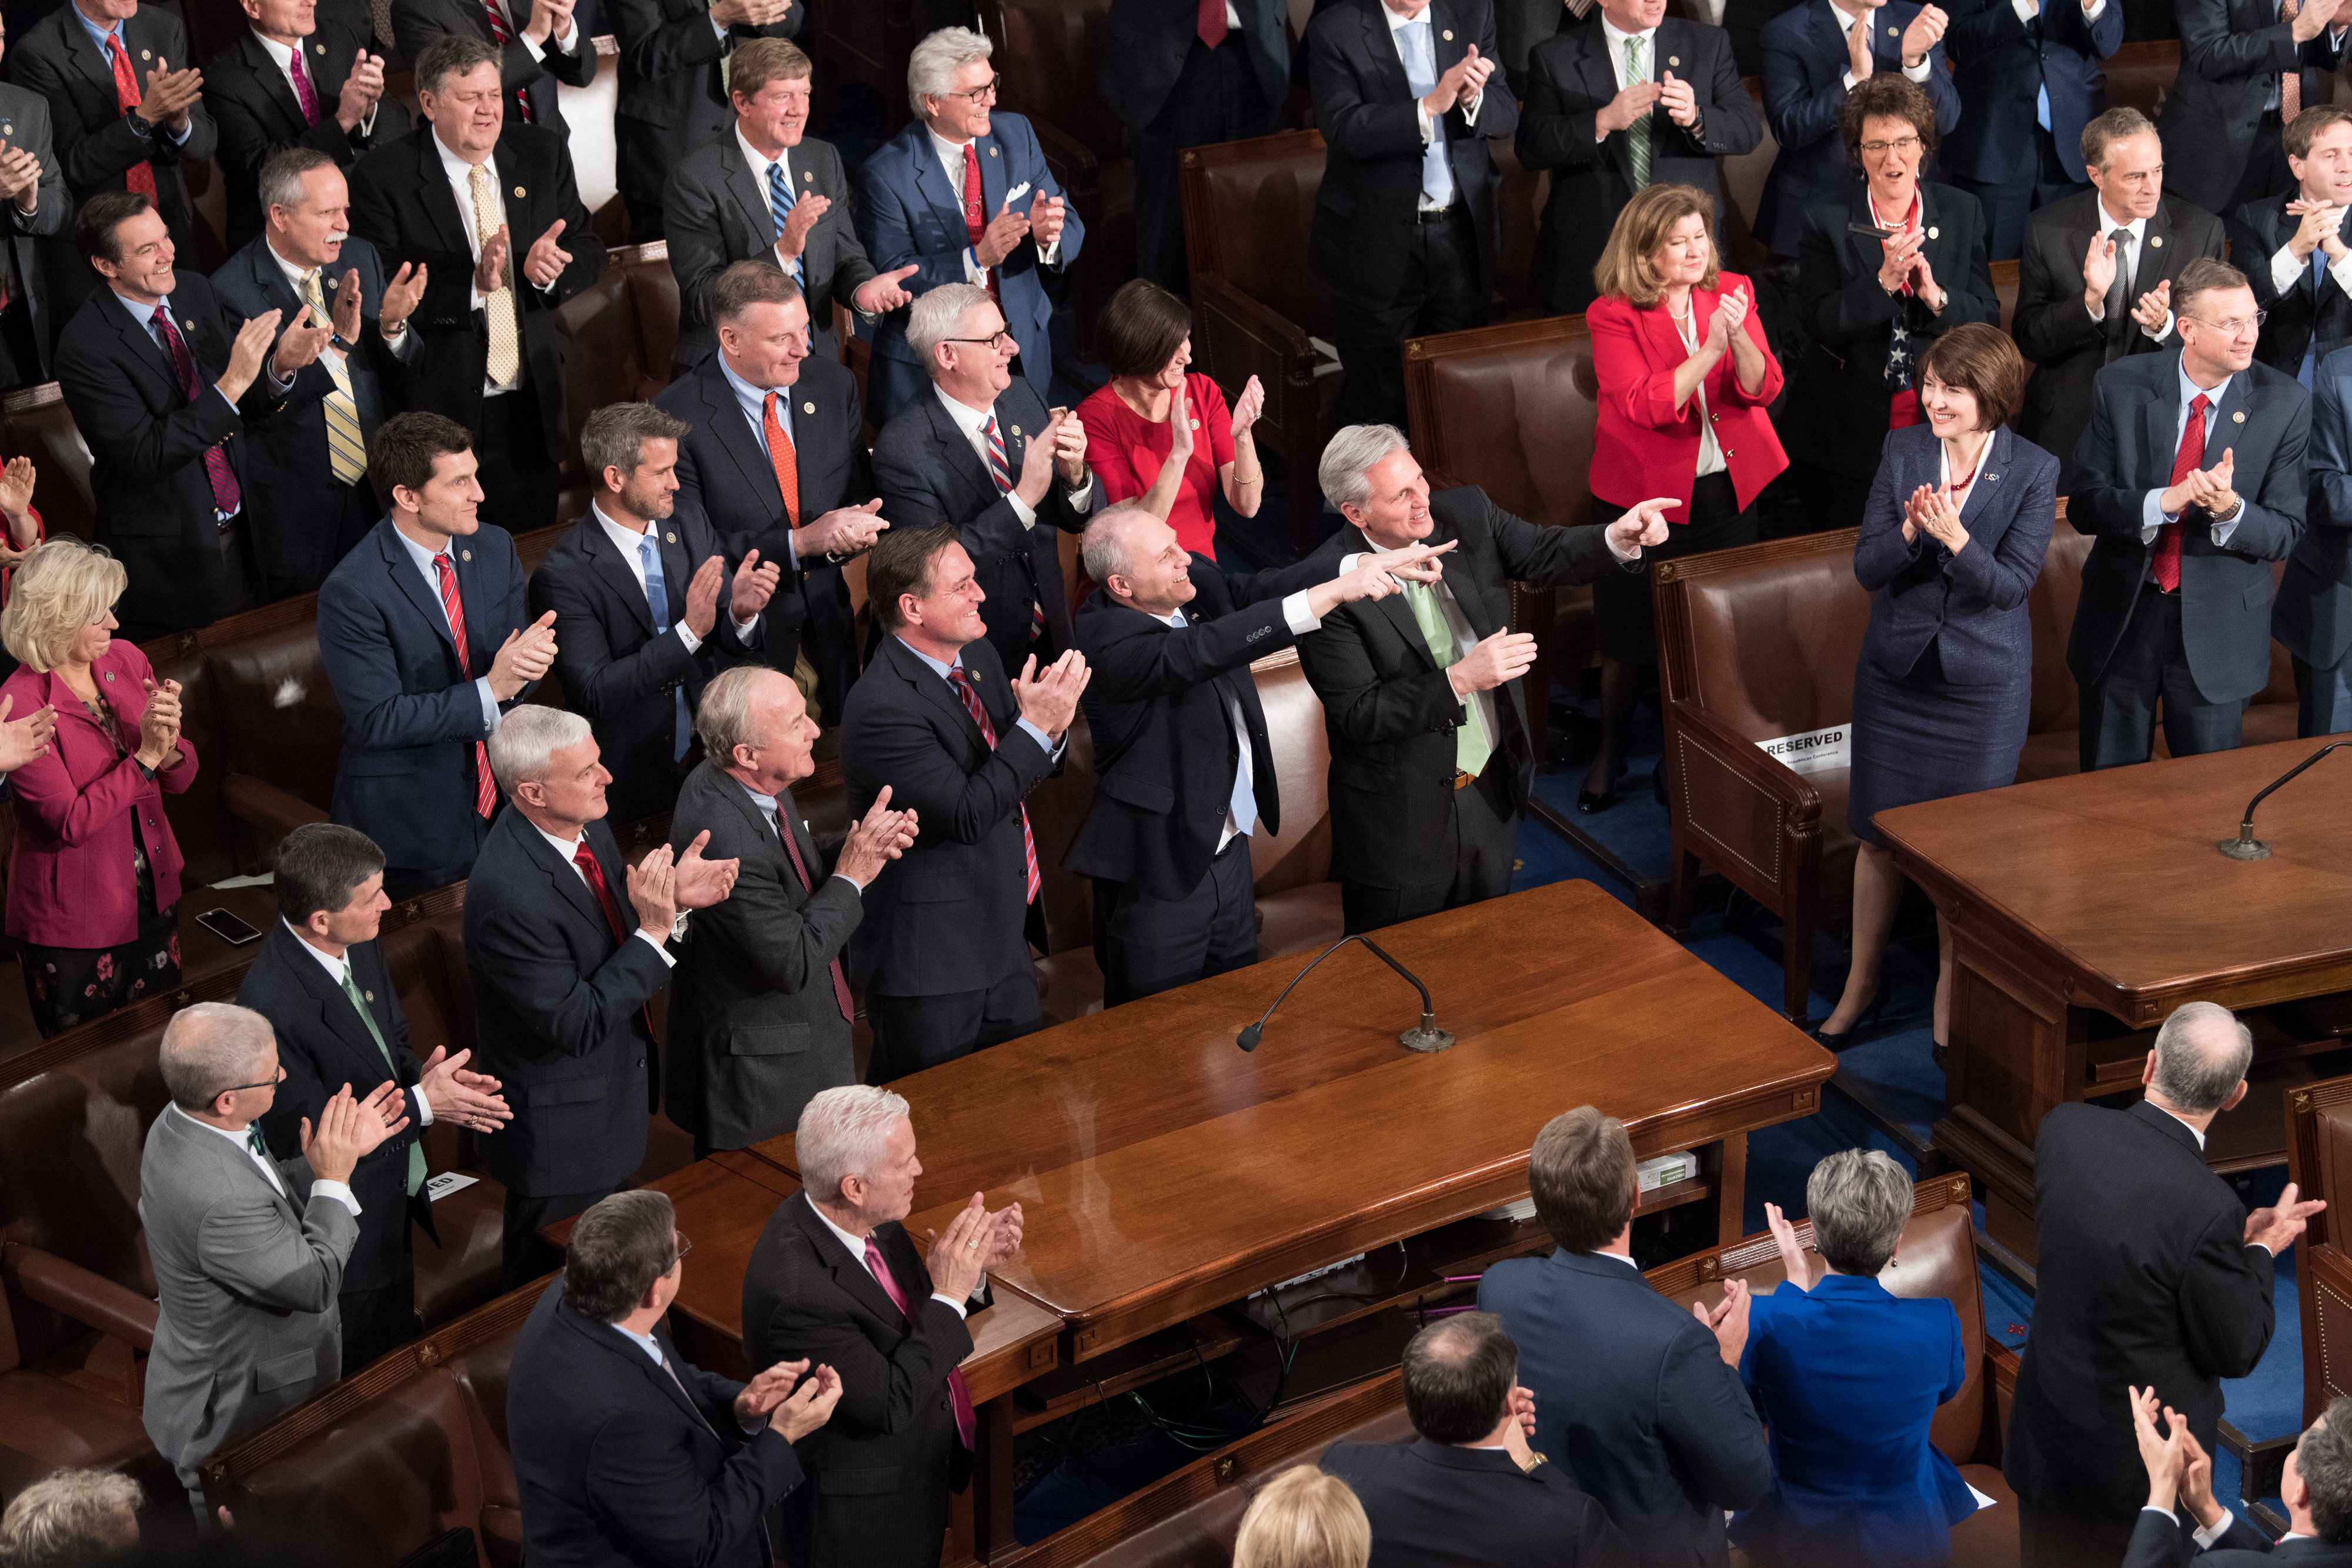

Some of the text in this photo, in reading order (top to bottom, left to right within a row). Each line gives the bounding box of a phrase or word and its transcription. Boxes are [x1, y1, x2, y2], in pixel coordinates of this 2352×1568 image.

[1984, 473, 2000, 482] USA
[684, 633, 694, 643] ADK
[1767, 731, 1843, 755] RESERVED
[1813, 751, 1839, 759] Conference
